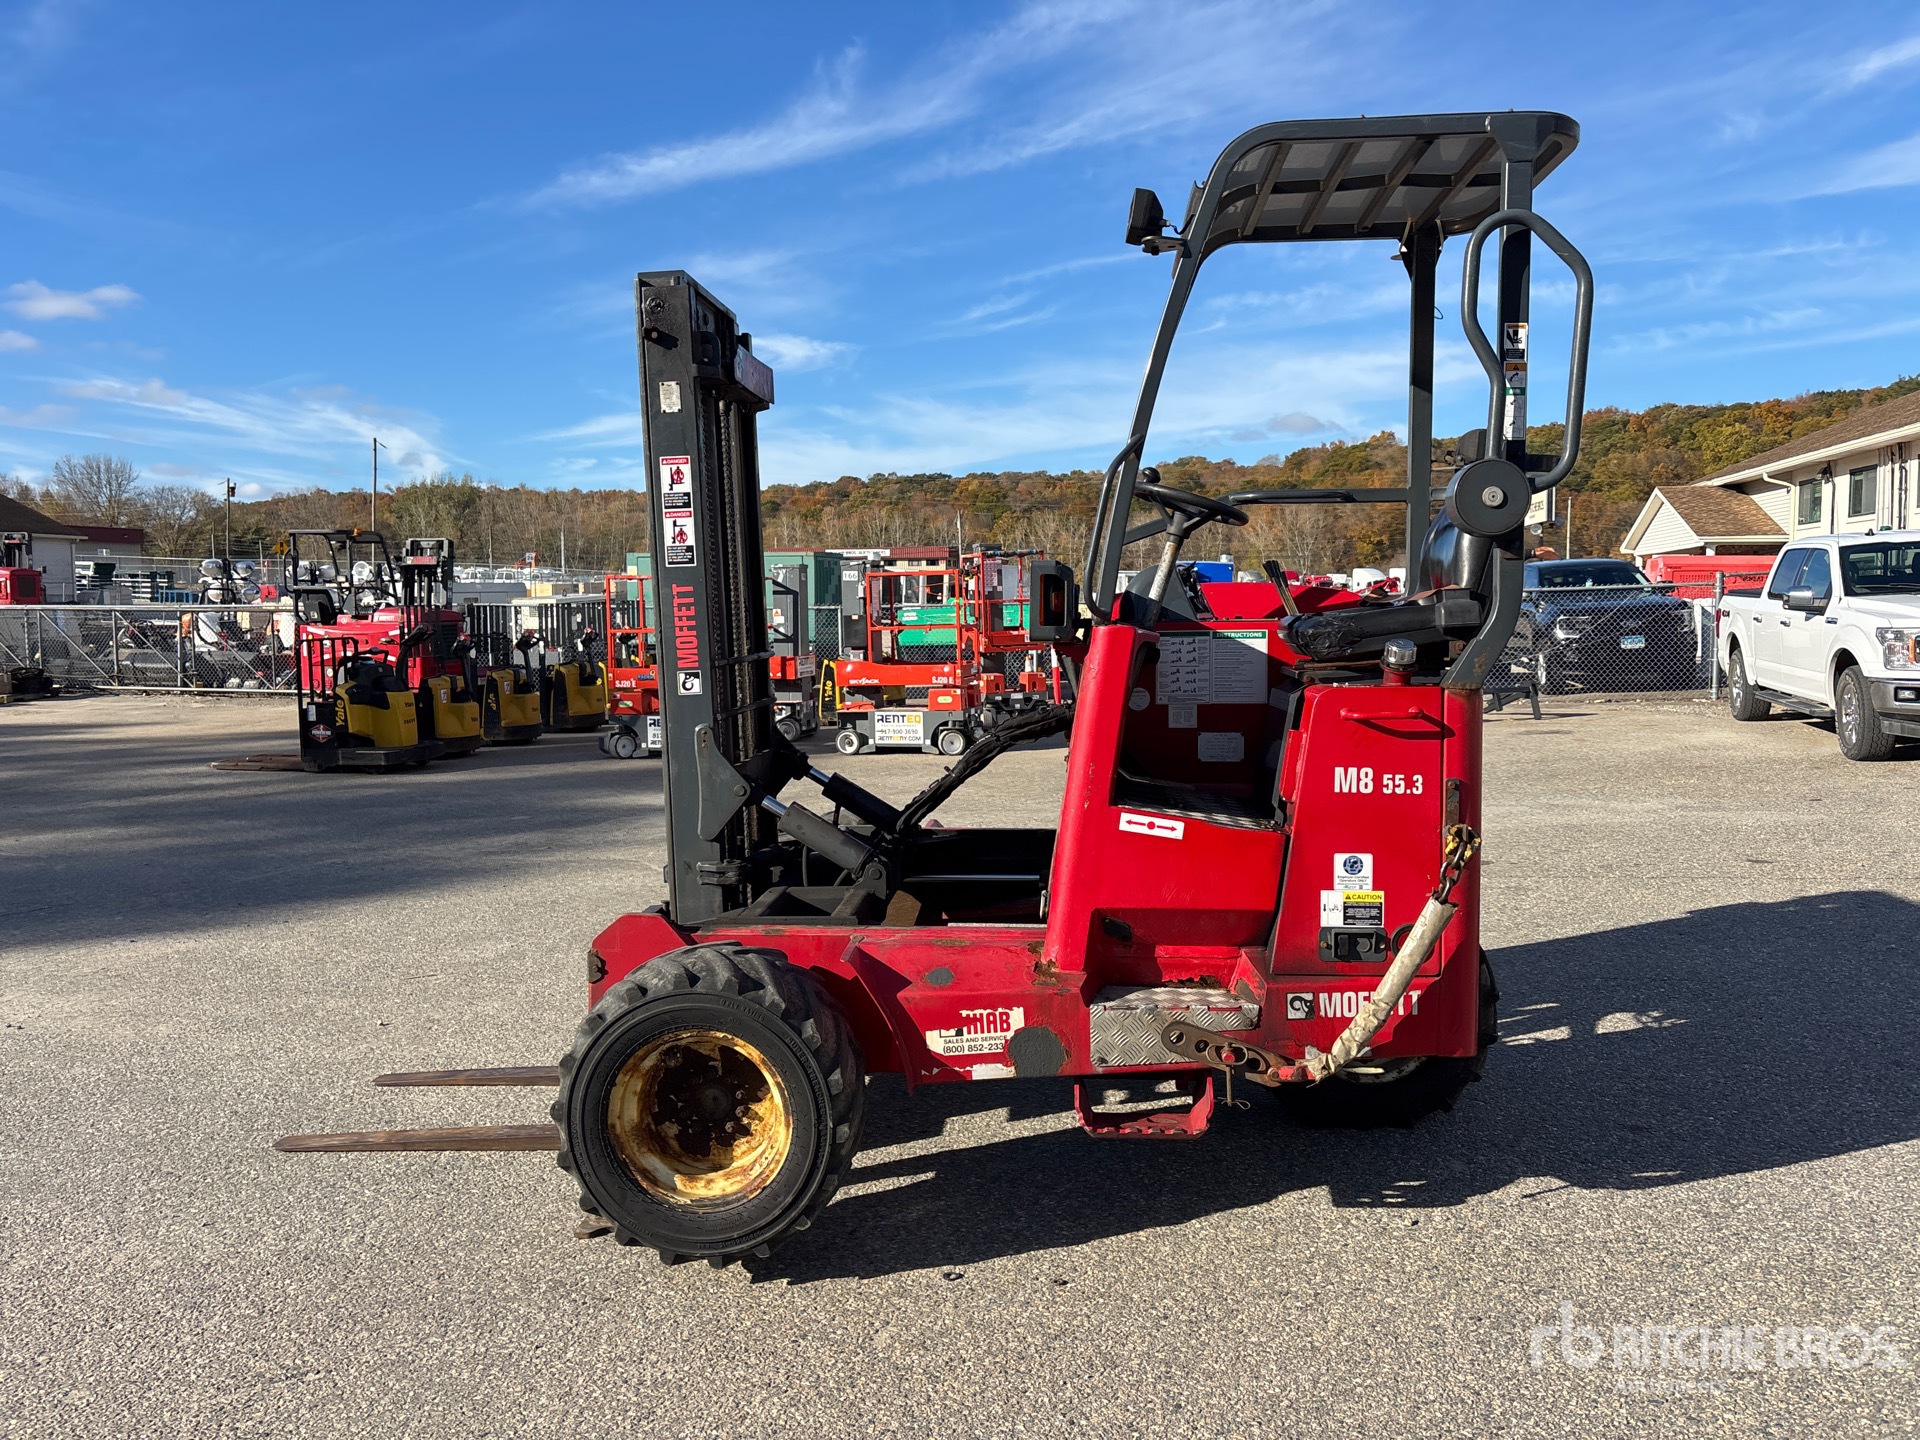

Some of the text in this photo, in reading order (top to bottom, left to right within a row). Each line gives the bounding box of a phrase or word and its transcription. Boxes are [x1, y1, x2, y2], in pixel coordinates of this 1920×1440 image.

[672, 584, 699, 668] MOFFETT
[615, 680, 631, 688] SJ20
[848, 677, 880, 685] SKYJACK
[931, 676, 948, 684] SJ20
[335, 699, 346, 727] Yale
[877, 714, 922, 724] RENTEQ
[1334, 766, 1423, 795] M8 55.3
[943, 1045, 965, 1055] (800)
